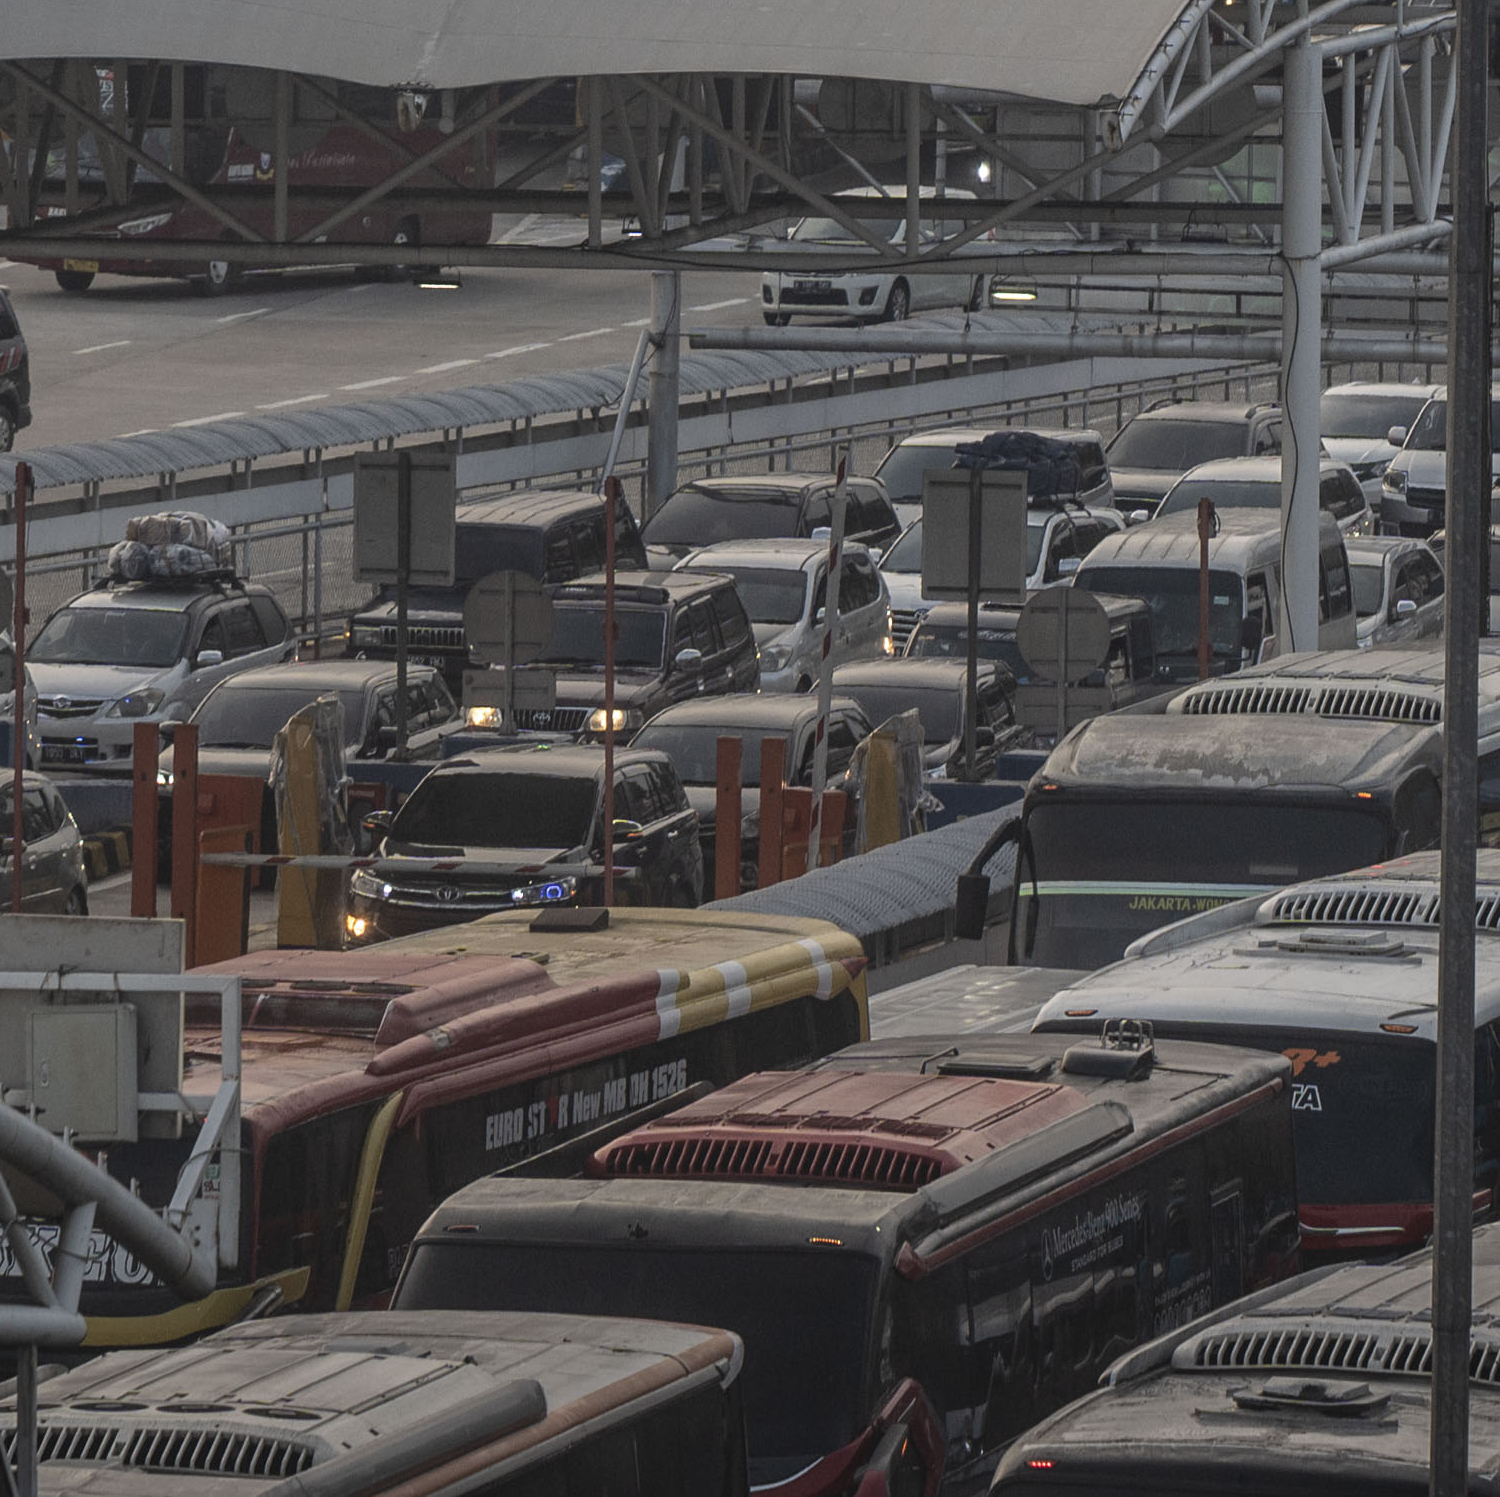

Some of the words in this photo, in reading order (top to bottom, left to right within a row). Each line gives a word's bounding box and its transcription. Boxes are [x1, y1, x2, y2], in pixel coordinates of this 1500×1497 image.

[485, 1107, 525, 1152] EURO
[571, 1087, 602, 1126] New
[603, 1076, 627, 1116] MB
[629, 1068, 651, 1108] OH
[651, 1057, 688, 1101] 1526
